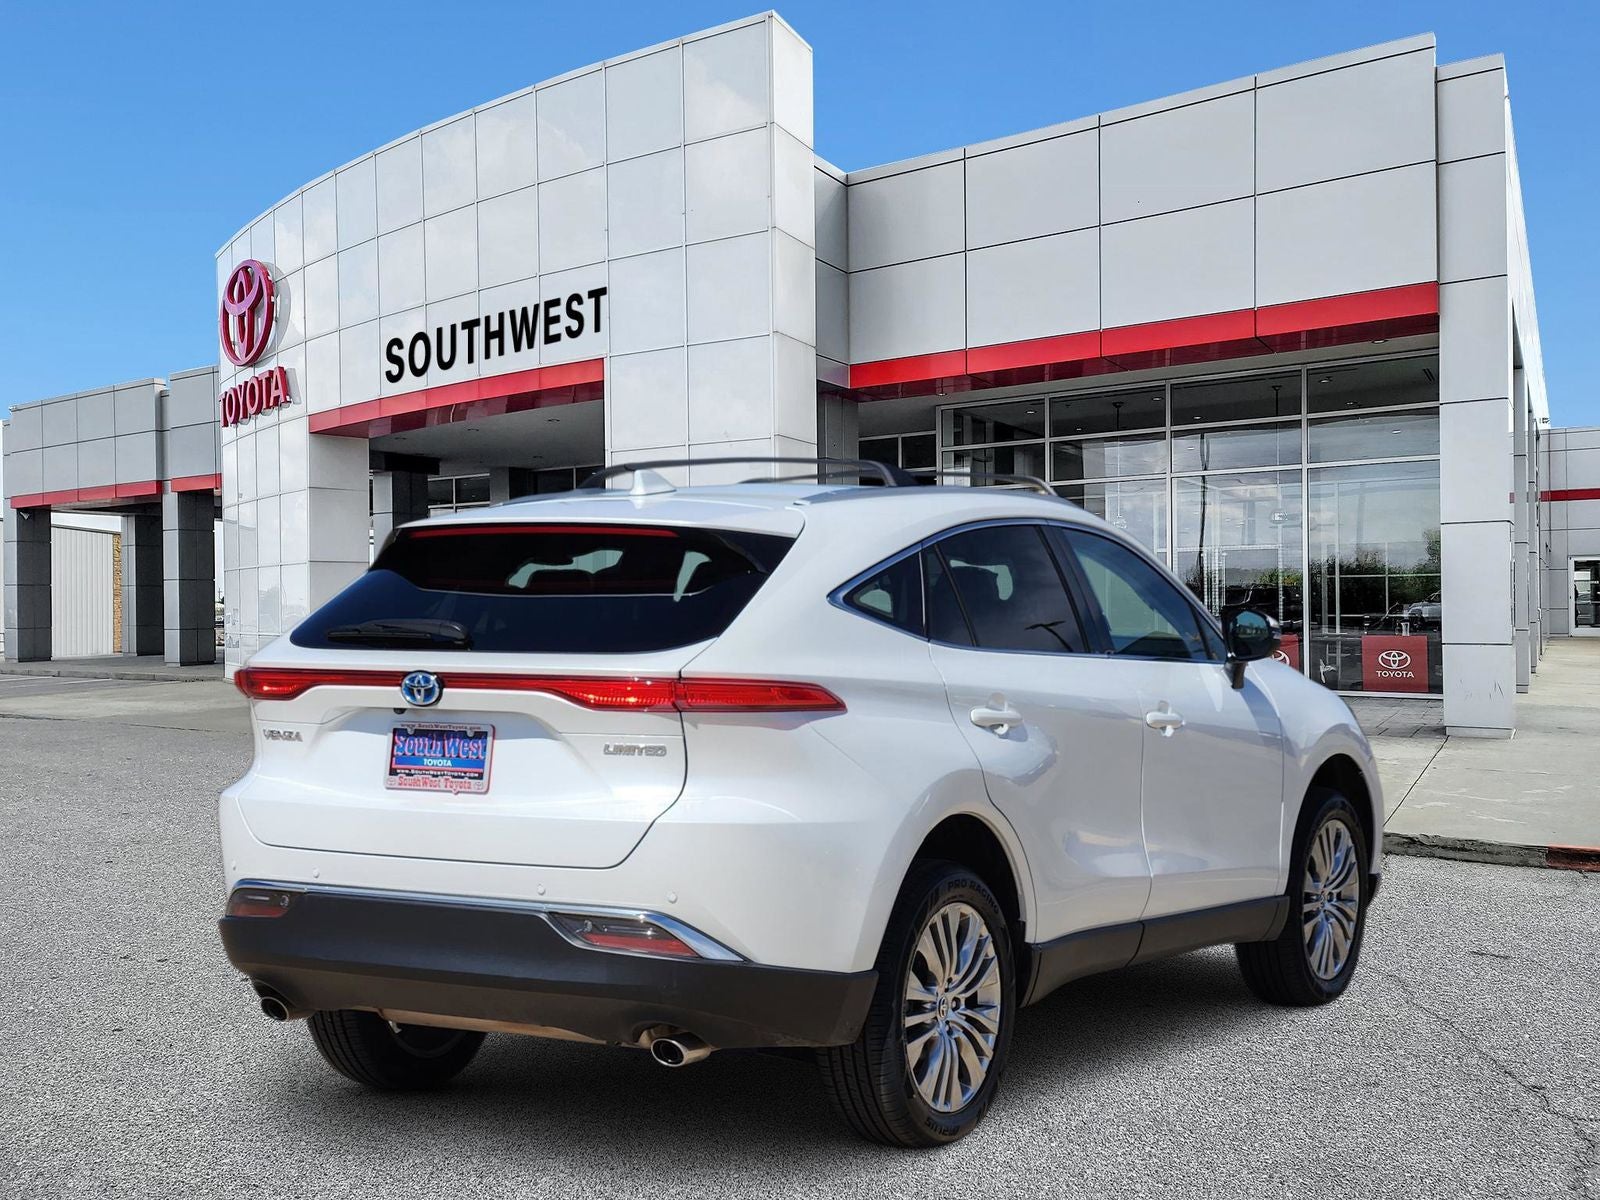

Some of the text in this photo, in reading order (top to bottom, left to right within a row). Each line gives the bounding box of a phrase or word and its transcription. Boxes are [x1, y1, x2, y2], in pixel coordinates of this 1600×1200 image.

[385, 287, 608, 383] SOUTHWEST
[218, 366, 291, 427] TOYOTA
[1376, 670, 1415, 678] TOYOTA
[262, 728, 304, 743] VENZA
[603, 743, 667, 758] LIMITED
[423, 758, 452, 767] TOYOTA
